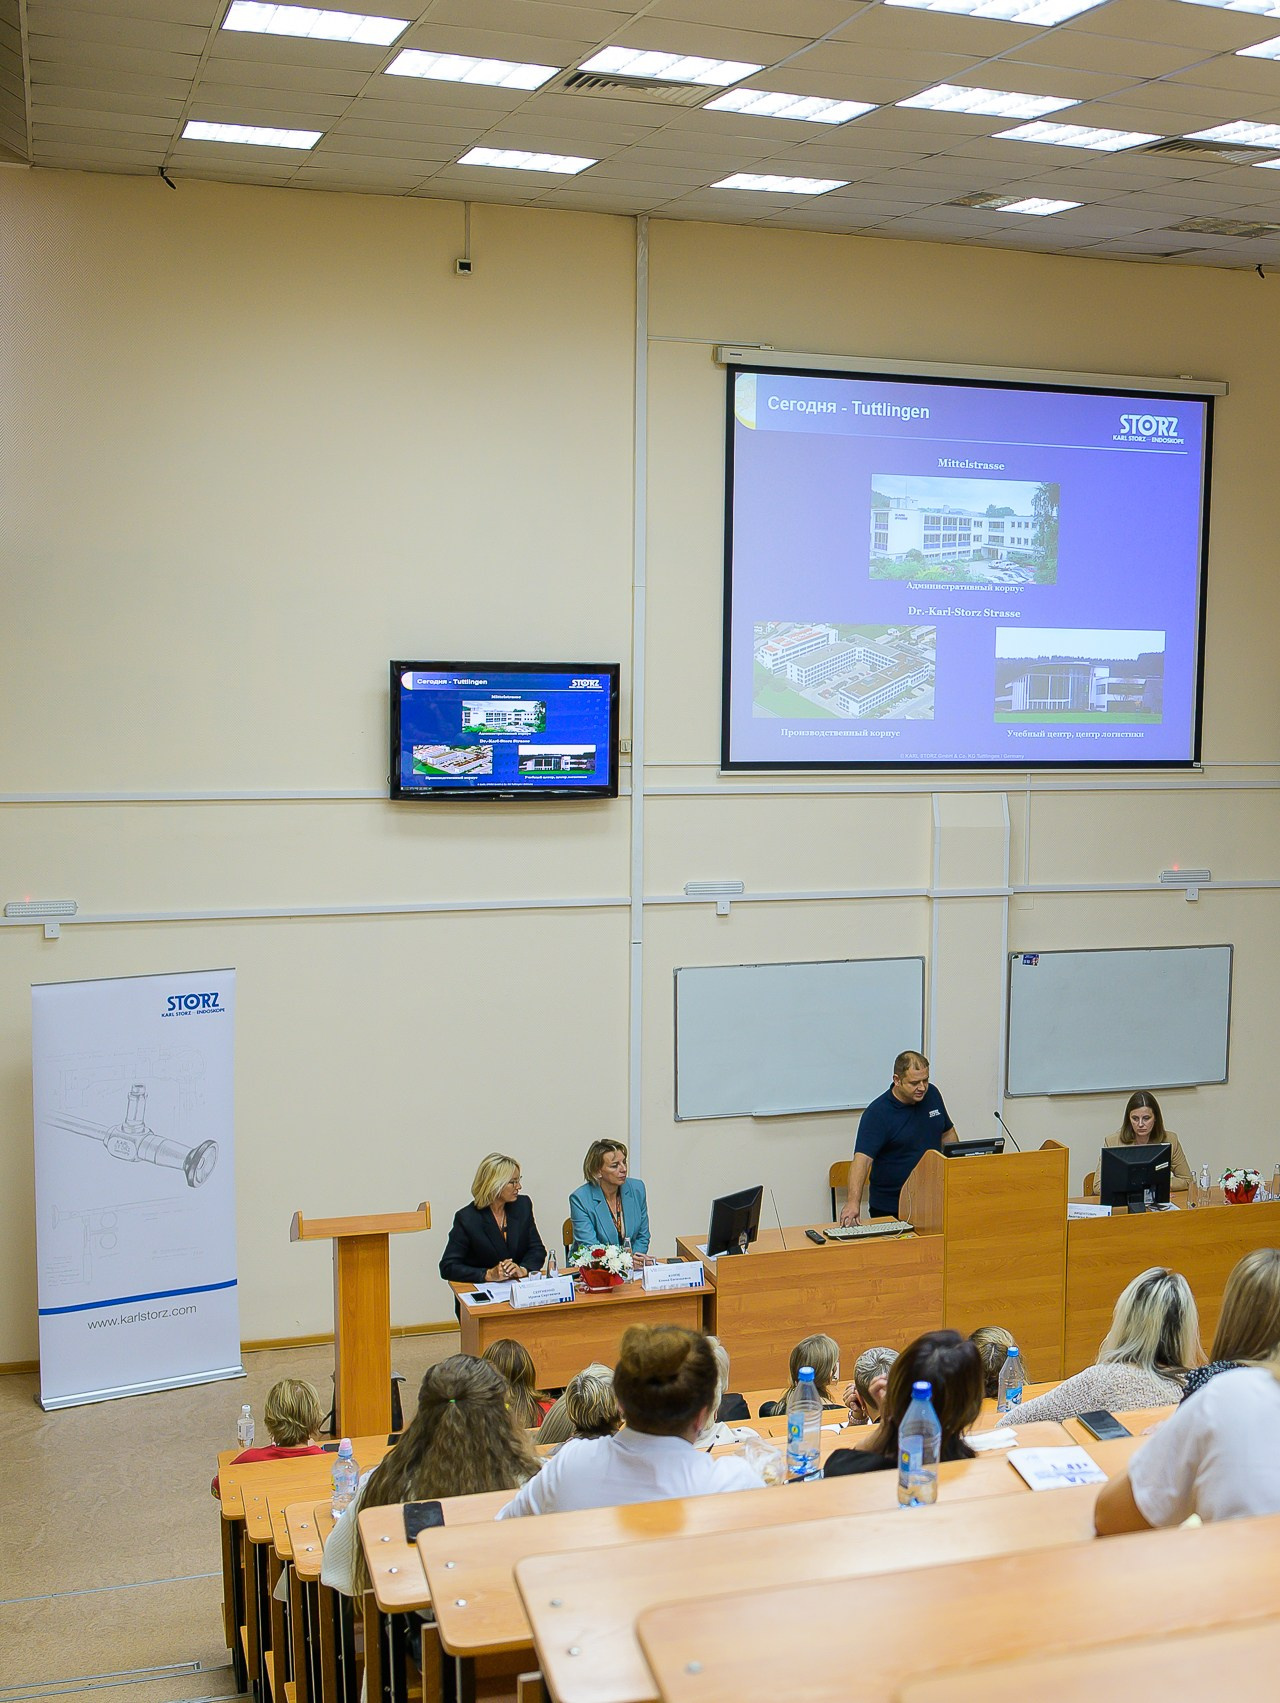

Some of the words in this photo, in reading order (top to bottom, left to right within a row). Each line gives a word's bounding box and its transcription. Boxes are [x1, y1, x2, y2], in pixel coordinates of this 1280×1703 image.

[768, 396, 836, 414] Сегодня
[852, 401, 930, 420] Tuttlingen
[1120, 414, 1178, 436] STORZ
[937, 458, 1005, 470] Mittelstrasse
[906, 582, 992, 592] Административный
[994, 585, 1025, 593] корпус
[908, 606, 982, 617] Dr.-Karl-Storz
[983, 608, 1021, 618] Strasse
[780, 728, 868, 737] Производственный
[870, 730, 900, 738] корпус
[1007, 729, 1045, 737] Учебный
[1047, 730, 1074, 739] центр,
[1075, 730, 1100, 738] центр
[1101, 730, 1145, 738] логистики
[167, 992, 219, 1011] STORZ
[87, 1304, 198, 1330] www.karlstorz.com
